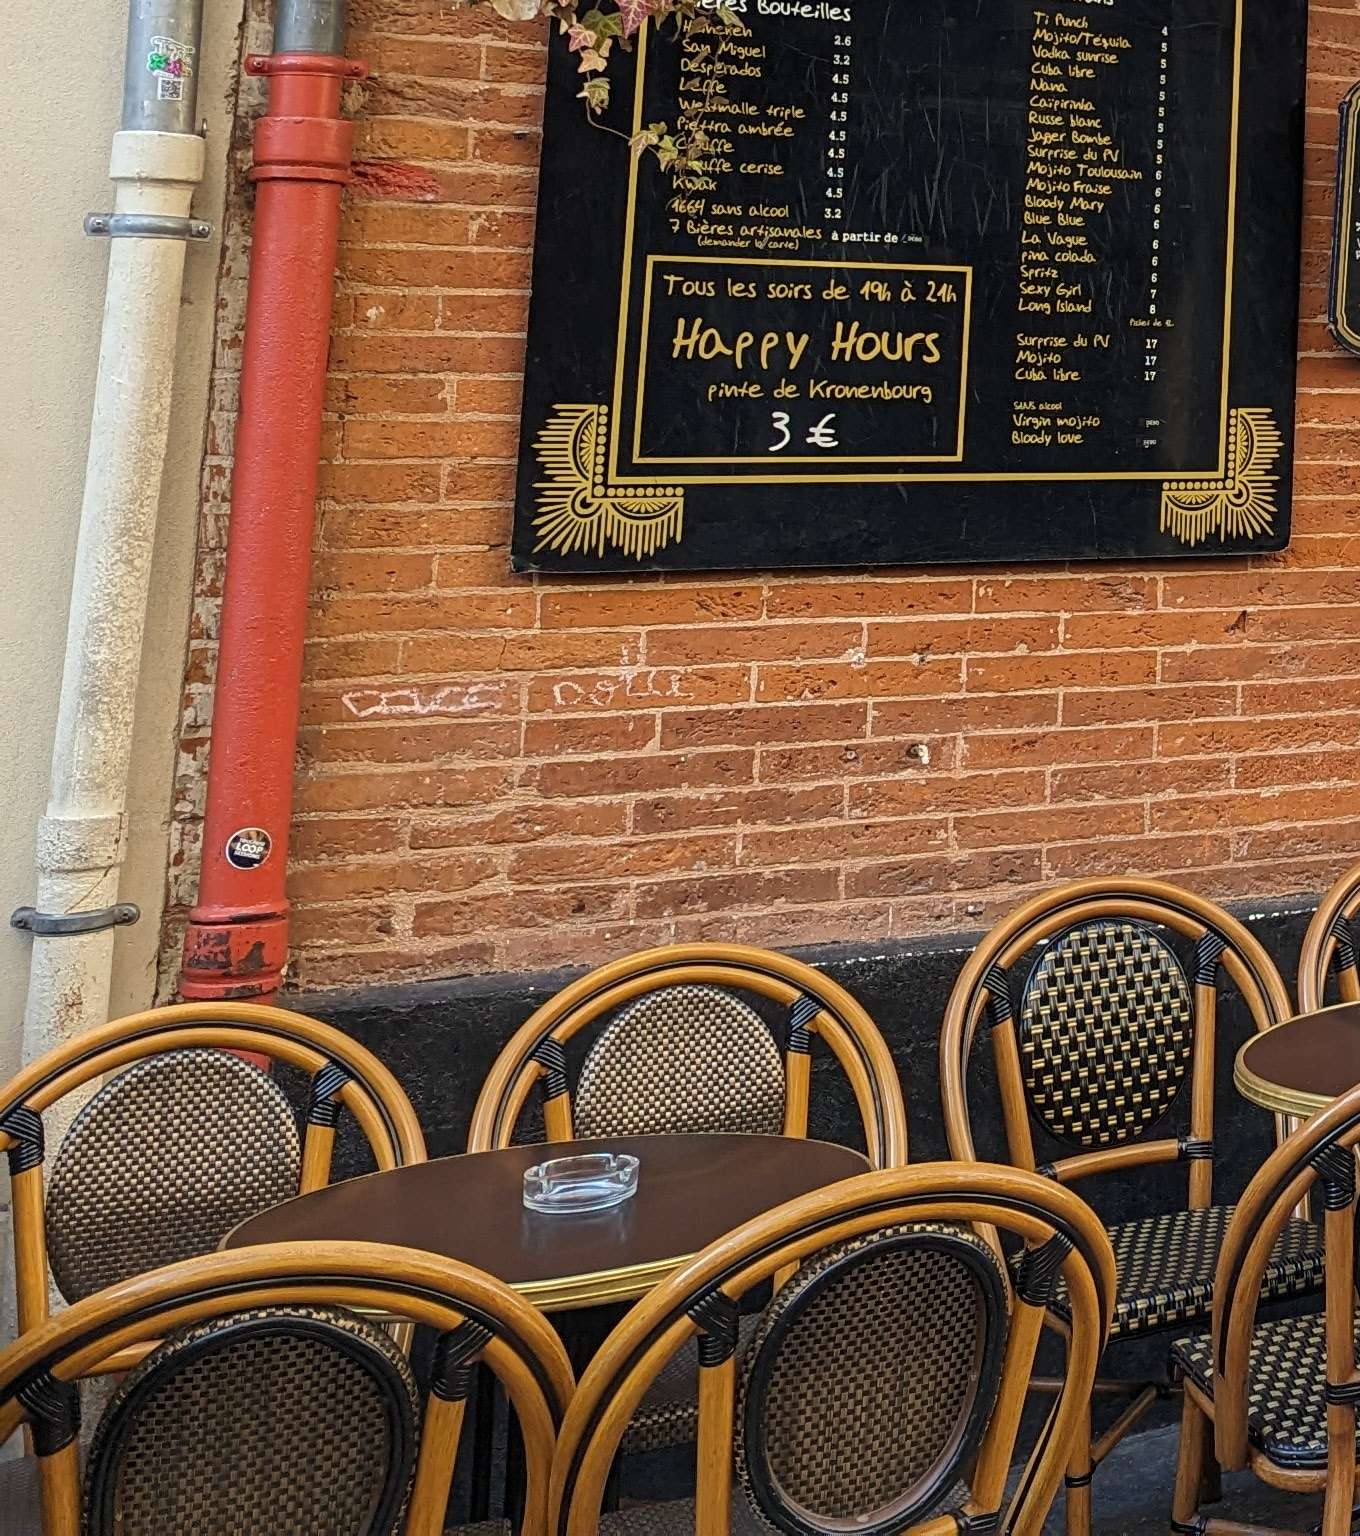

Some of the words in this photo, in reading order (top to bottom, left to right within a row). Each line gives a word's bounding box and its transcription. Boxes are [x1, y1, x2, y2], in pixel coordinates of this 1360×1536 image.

[1033, 11, 1050, 25] Ti
[1054, 12, 1089, 29] Punch
[834, 34, 852, 47] 2.6
[682, 41, 711, 54] San
[717, 40, 766, 60] Miguel
[832, 54, 851, 66] 3.2
[1031, 44, 1071, 60] Vodka
[1076, 51, 1119, 64] sunrise
[680, 60, 761, 77] Desperados
[831, 73, 850, 85] 4.5
[1031, 61, 1063, 76] Cuba
[1068, 64, 1096, 79] libre
[1029, 77, 1068, 93] Nana
[830, 92, 849, 104] 4.5
[678, 98, 760, 116] Westmalle
[765, 104, 806, 121] triple
[829, 110, 847, 122] 4.5
[1028, 110, 1065, 126] Russe
[1069, 113, 1103, 129] blanc
[737, 121, 795, 137] ambrée
[828, 130, 846, 142] 4.5
[827, 147, 845, 159] 4.5
[1027, 144, 1078, 161] Surprise
[1082, 147, 1098, 161] du
[1102, 148, 1120, 163] PV
[739, 162, 785, 175] cerise
[826, 167, 844, 178] 4.5
[1026, 160, 1072, 178] Mojito
[1076, 163, 1143, 180] Toulousain
[825, 187, 843, 199] 4.5
[1025, 177, 1071, 195] Mojito
[1072, 180, 1113, 195] Fraise
[671, 196, 706, 216] 1664
[710, 203, 743, 216] sans
[748, 203, 789, 218] alcool
[824, 207, 842, 219] 3.2
[1024, 194, 1065, 212] Bloody
[1069, 196, 1105, 214] Mary
[1023, 210, 1053, 225] Blue
[1057, 212, 1086, 227] Blue
[669, 218, 680, 233] 7
[686, 218, 734, 236] Bières
[739, 224, 822, 243] artisanales
[842, 231, 882, 243] partir
[883, 232, 899, 244] de
[1021, 230, 1042, 245] La
[1047, 231, 1089, 249] Vague
[1054, 249, 1097, 264] colada
[1019, 264, 1059, 281] Spritz
[663, 274, 716, 297] Tous
[727, 277, 757, 298] les
[767, 283, 812, 300] soirs
[822, 278, 850, 300] de
[859, 280, 892, 302] 19h
[900, 280, 917, 303] à
[925, 280, 957, 303] 21h
[1019, 281, 1051, 298] Sexy
[1055, 282, 1082, 299] Girl
[1017, 297, 1051, 315] Long
[1056, 299, 1092, 313] Island
[672, 317, 810, 370] Happy
[831, 320, 941, 364] Hours
[1016, 333, 1068, 349] Surprise
[1073, 333, 1088, 348] du
[1093, 334, 1110, 348] PV
[1015, 349, 1062, 367] Mojito
[1144, 355, 1158, 366] 17
[1014, 367, 1048, 382] Cuba
[1053, 367, 1081, 382] libre
[1144, 371, 1157, 381] 17
[708, 381, 764, 402] pinte
[773, 377, 801, 399] de
[809, 378, 933, 404] Kronenbourg
[1012, 413, 1052, 430] Virgin
[1056, 415, 1101, 430] mojito
[768, 411, 791, 452] 3
[805, 413, 839, 448] €
[1011, 430, 1052, 447] Bloody
[1057, 431, 1084, 444] love
